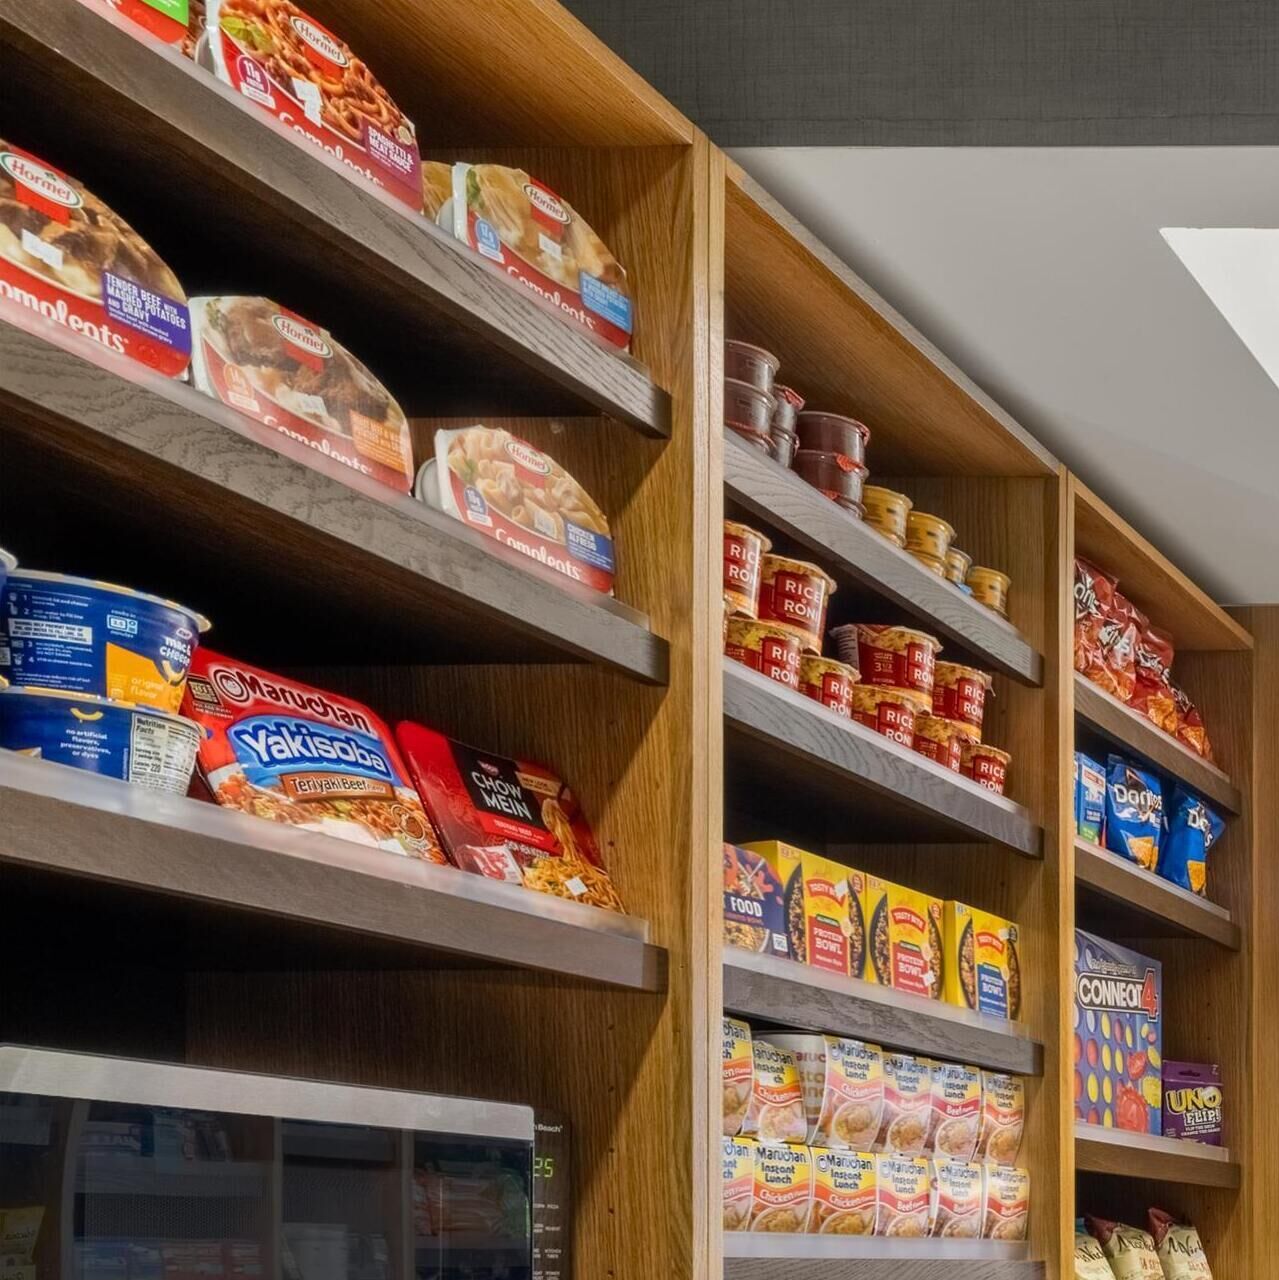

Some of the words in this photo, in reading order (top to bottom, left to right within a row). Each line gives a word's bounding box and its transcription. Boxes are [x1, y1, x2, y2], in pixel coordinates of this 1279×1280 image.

[300, 22, 341, 60] Hormel
[11, 159, 71, 201] Hormel
[530, 188, 565, 218] Hormel
[105, 272, 138, 298] TENDER
[141, 287, 162, 308] BEEF
[107, 285, 143, 309] MASHED
[145, 298, 187, 330] POTATOES
[122, 301, 151, 323] GRAVY
[280, 319, 325, 352] Hormel
[512, 444, 547, 471] Hormel
[785, 580, 823, 603] RICE
[235, 670, 373, 734] Maruchan
[136, 718, 167, 730] Nutrition
[886, 709, 914, 730] RICE
[136, 726, 155, 736] Facts
[241, 722, 388, 773] Yakisoba
[290, 776, 342, 794] Teriyaki
[342, 778, 367, 791] Beef
[471, 771, 524, 801] CHOW
[479, 788, 534, 822] MEIN
[730, 896, 763, 918] FOOD
[814, 937, 843, 955] BOWL
[898, 962, 924, 977] BOWL
[982, 983, 1005, 998] BOWL
[1079, 976, 1143, 1009] CONNECT
[1141, 969, 1159, 1022] 4
[837, 1041, 881, 1062] Maruchan
[841, 1058, 871, 1073] Instant
[844, 1068, 868, 1081] Lunch
[943, 1088, 966, 1100] Lunch
[1166, 1086, 1223, 1114] UNO
[1184, 1110, 1221, 1126] FLIP!
[757, 1146, 807, 1164] Maruchan
[825, 1153, 874, 1171] Maruchan
[760, 1162, 796, 1175] Instant
[764, 1173, 793, 1185] Lunch
[830, 1169, 863, 1181] Instant
[833, 1178, 860, 1190] Lunch
[894, 1183, 917, 1194] Lunch
